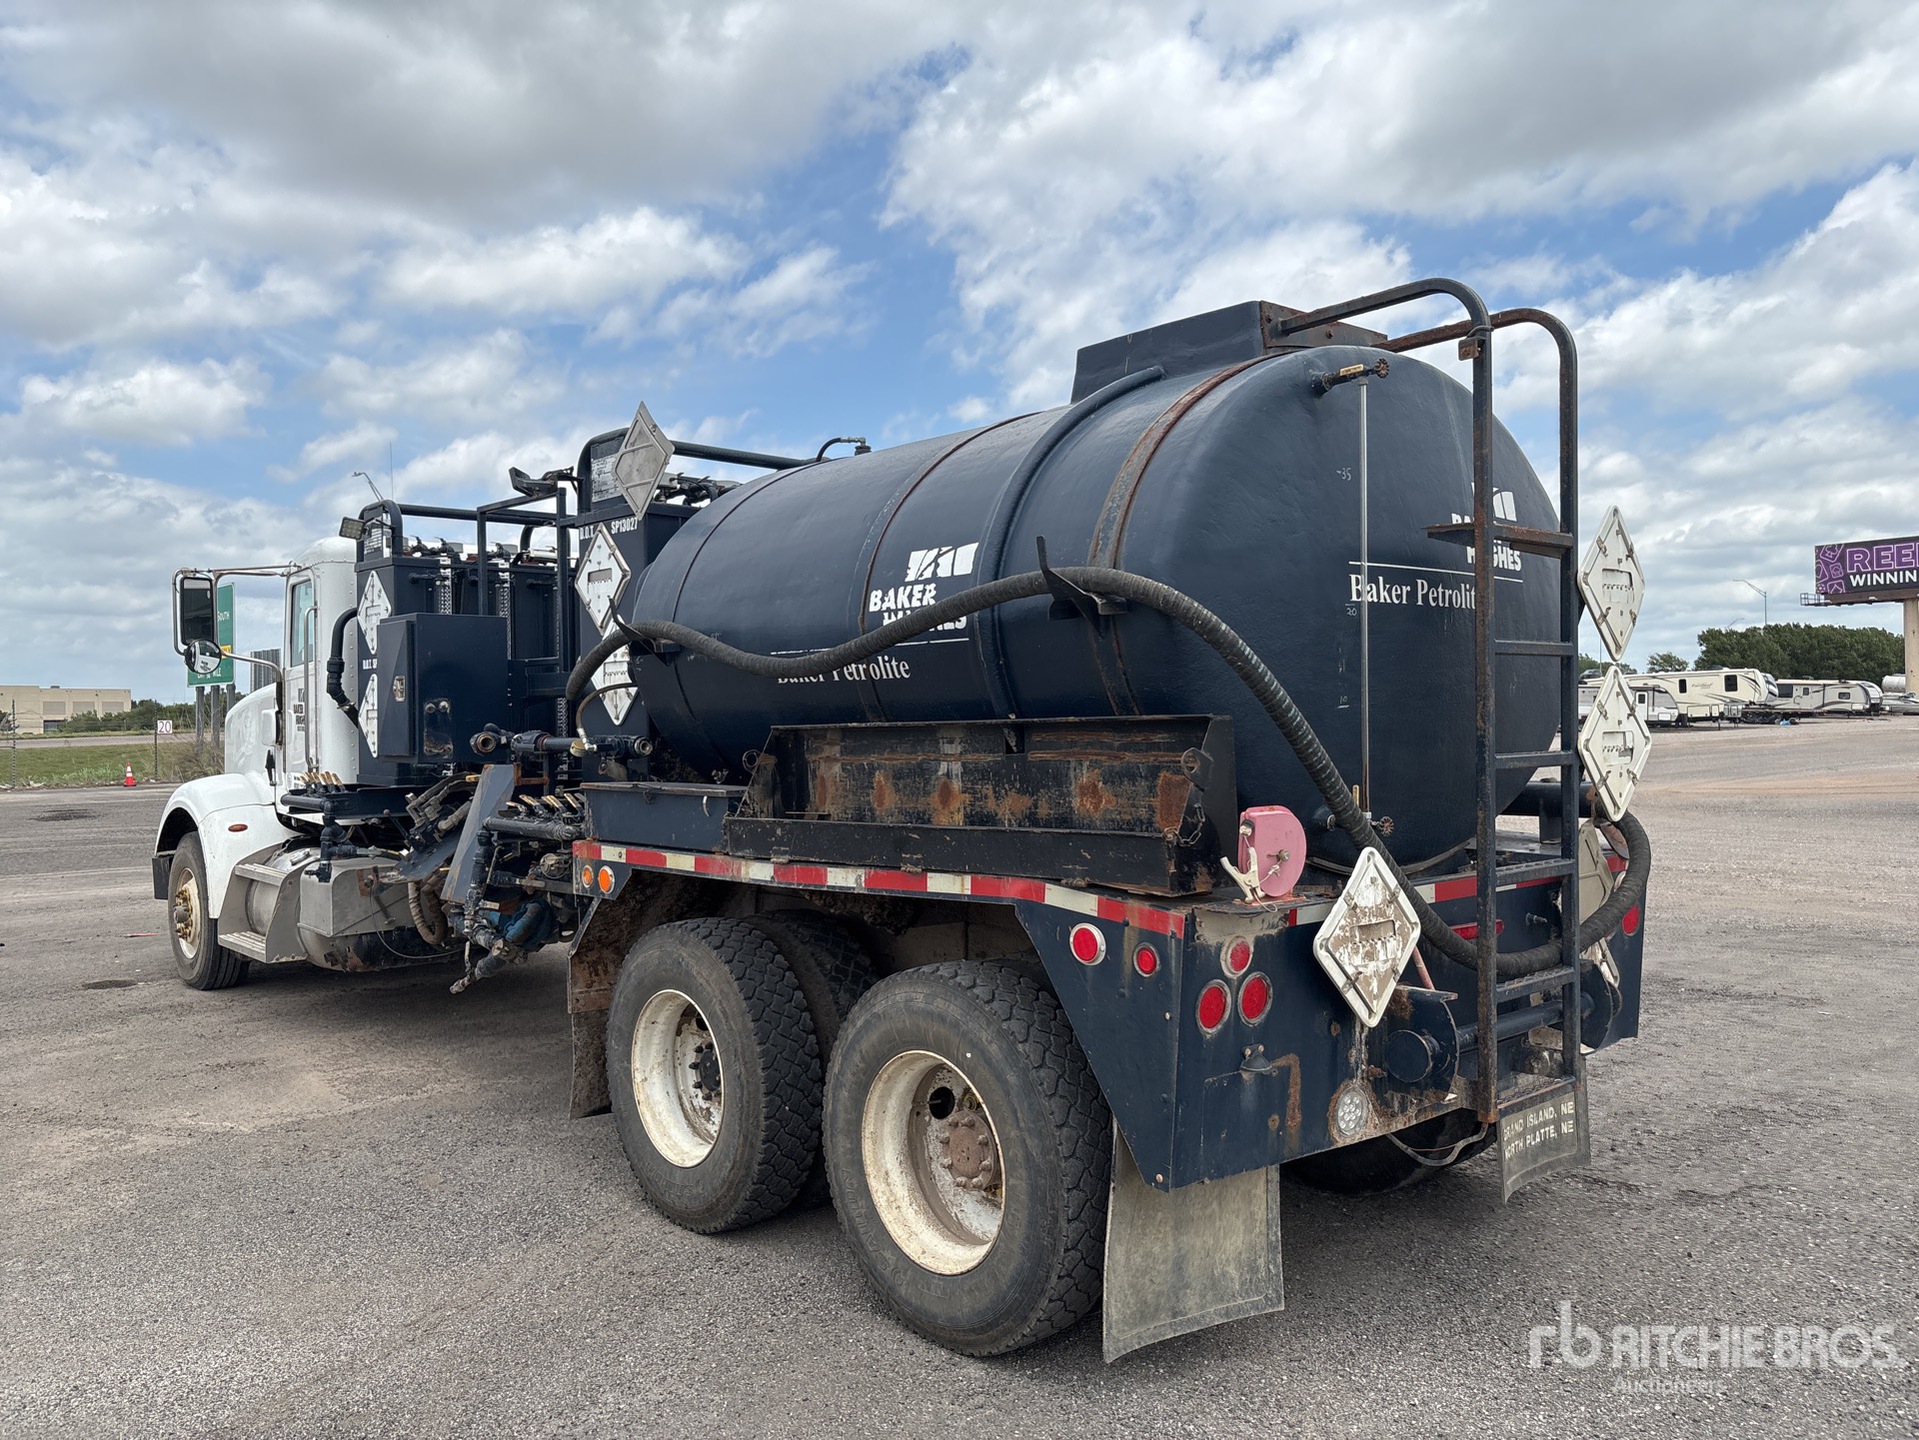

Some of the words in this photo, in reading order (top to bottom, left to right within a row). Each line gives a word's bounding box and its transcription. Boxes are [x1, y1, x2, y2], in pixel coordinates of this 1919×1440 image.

[611, 516, 638, 535] SP13027
[1466, 544, 1521, 572] HHES
[1847, 543, 1919, 573] REE
[869, 582, 937, 613] BAKER
[1349, 573, 1411, 605] Baker
[1416, 578, 1476, 610] Petrolit
[158, 720, 172, 733] 20
[1561, 1101, 1574, 1115] NE
[1561, 1120, 1574, 1133] NE
